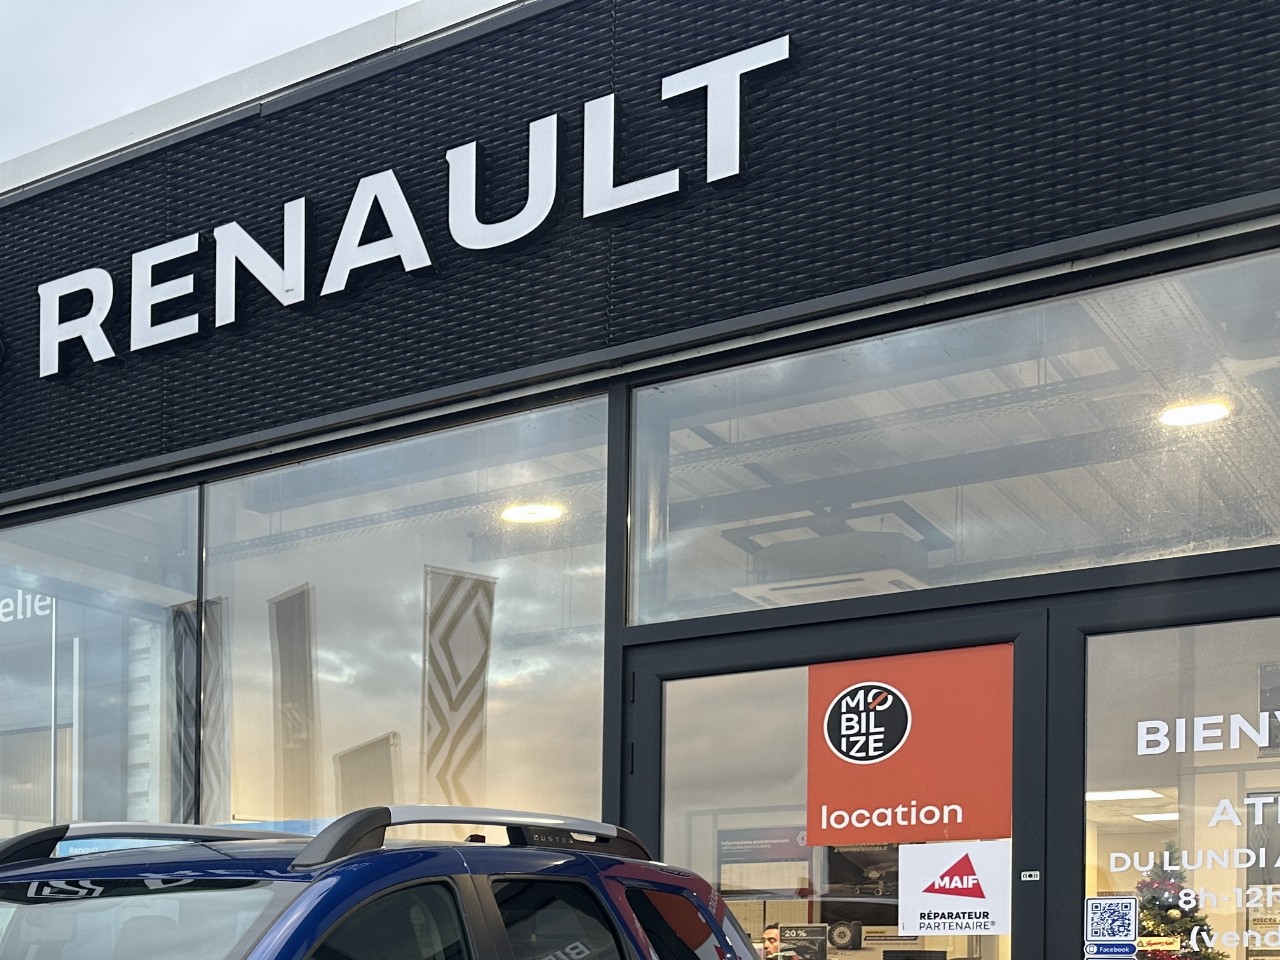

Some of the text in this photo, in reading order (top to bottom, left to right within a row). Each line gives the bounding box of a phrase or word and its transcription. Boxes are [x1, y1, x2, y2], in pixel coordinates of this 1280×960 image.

[37, 35, 790, 378] RENAULT
[1137, 711, 1280, 756] BIEN
[821, 801, 964, 830] location
[1208, 796, 1280, 827] AT
[1110, 852, 1155, 872] DU
[1163, 848, 1265, 871] LUNDI
[934, 874, 979, 889] MAIF
[919, 910, 990, 921] RÉPARATEUR
[1099, 945, 1130, 953] Facebook
